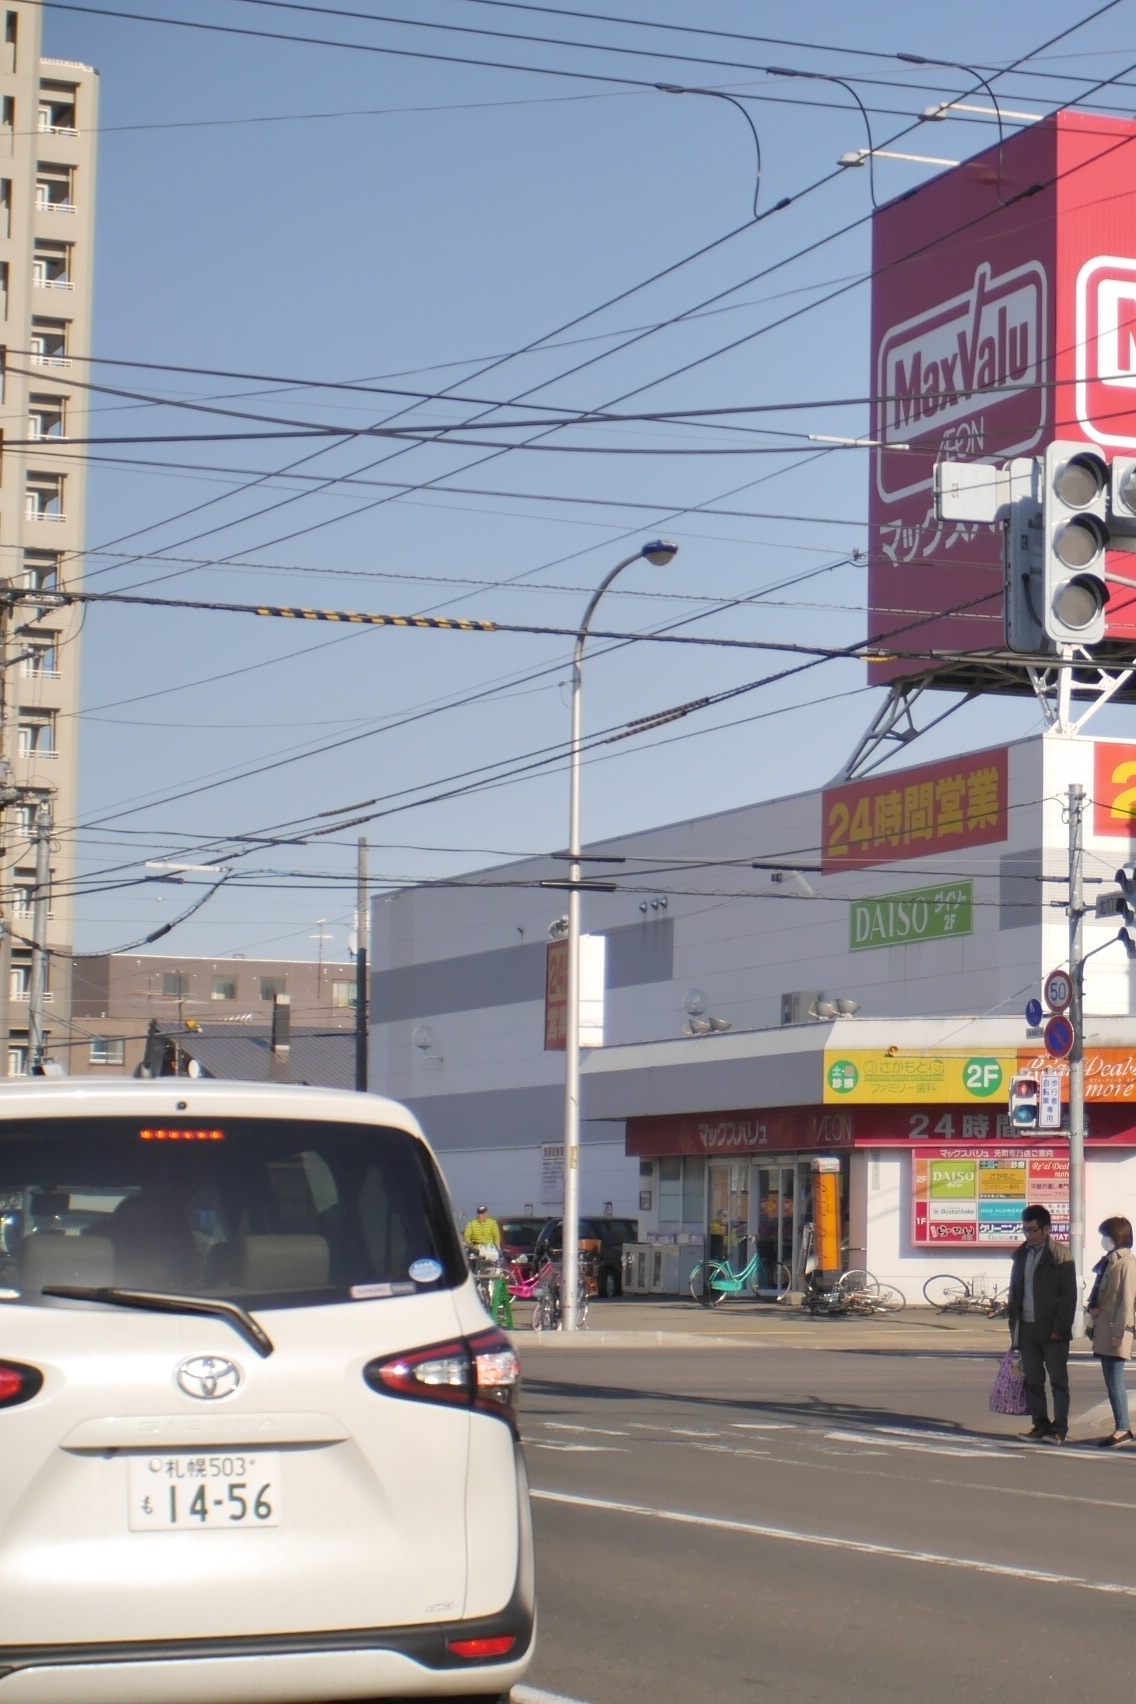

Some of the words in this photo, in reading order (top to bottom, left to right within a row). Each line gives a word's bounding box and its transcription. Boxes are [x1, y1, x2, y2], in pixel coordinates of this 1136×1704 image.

[895, 272, 1028, 430] MaxValu
[827, 767, 999, 857] 24時間営業
[934, 889, 967, 914] ダイソー
[856, 897, 929, 943] DAISO
[944, 914, 956, 931] 2F
[1050, 982, 1066, 1001] 50
[879, 1060, 927, 1074] さかもと
[967, 1065, 999, 1088] 2F
[832, 1078, 854, 1089] 診療
[871, 1083, 936, 1094] ファミリー歯科
[1042, 1079, 1050, 1104] 自転車
[1051, 1079, 1059, 1105] 歩行者
[1085, 1082, 1135, 1098] more
[1046, 1106, 1054, 1123] 専用
[699, 1120, 768, 1147] マックスバリュ
[940, 1150, 989, 1158] マックスバリュ
[916, 1175, 927, 1183] 2F
[933, 1171, 974, 1181] DAISO
[142, 1495, 153, 1515] も
[169, 1483, 273, 1524] 14-56
